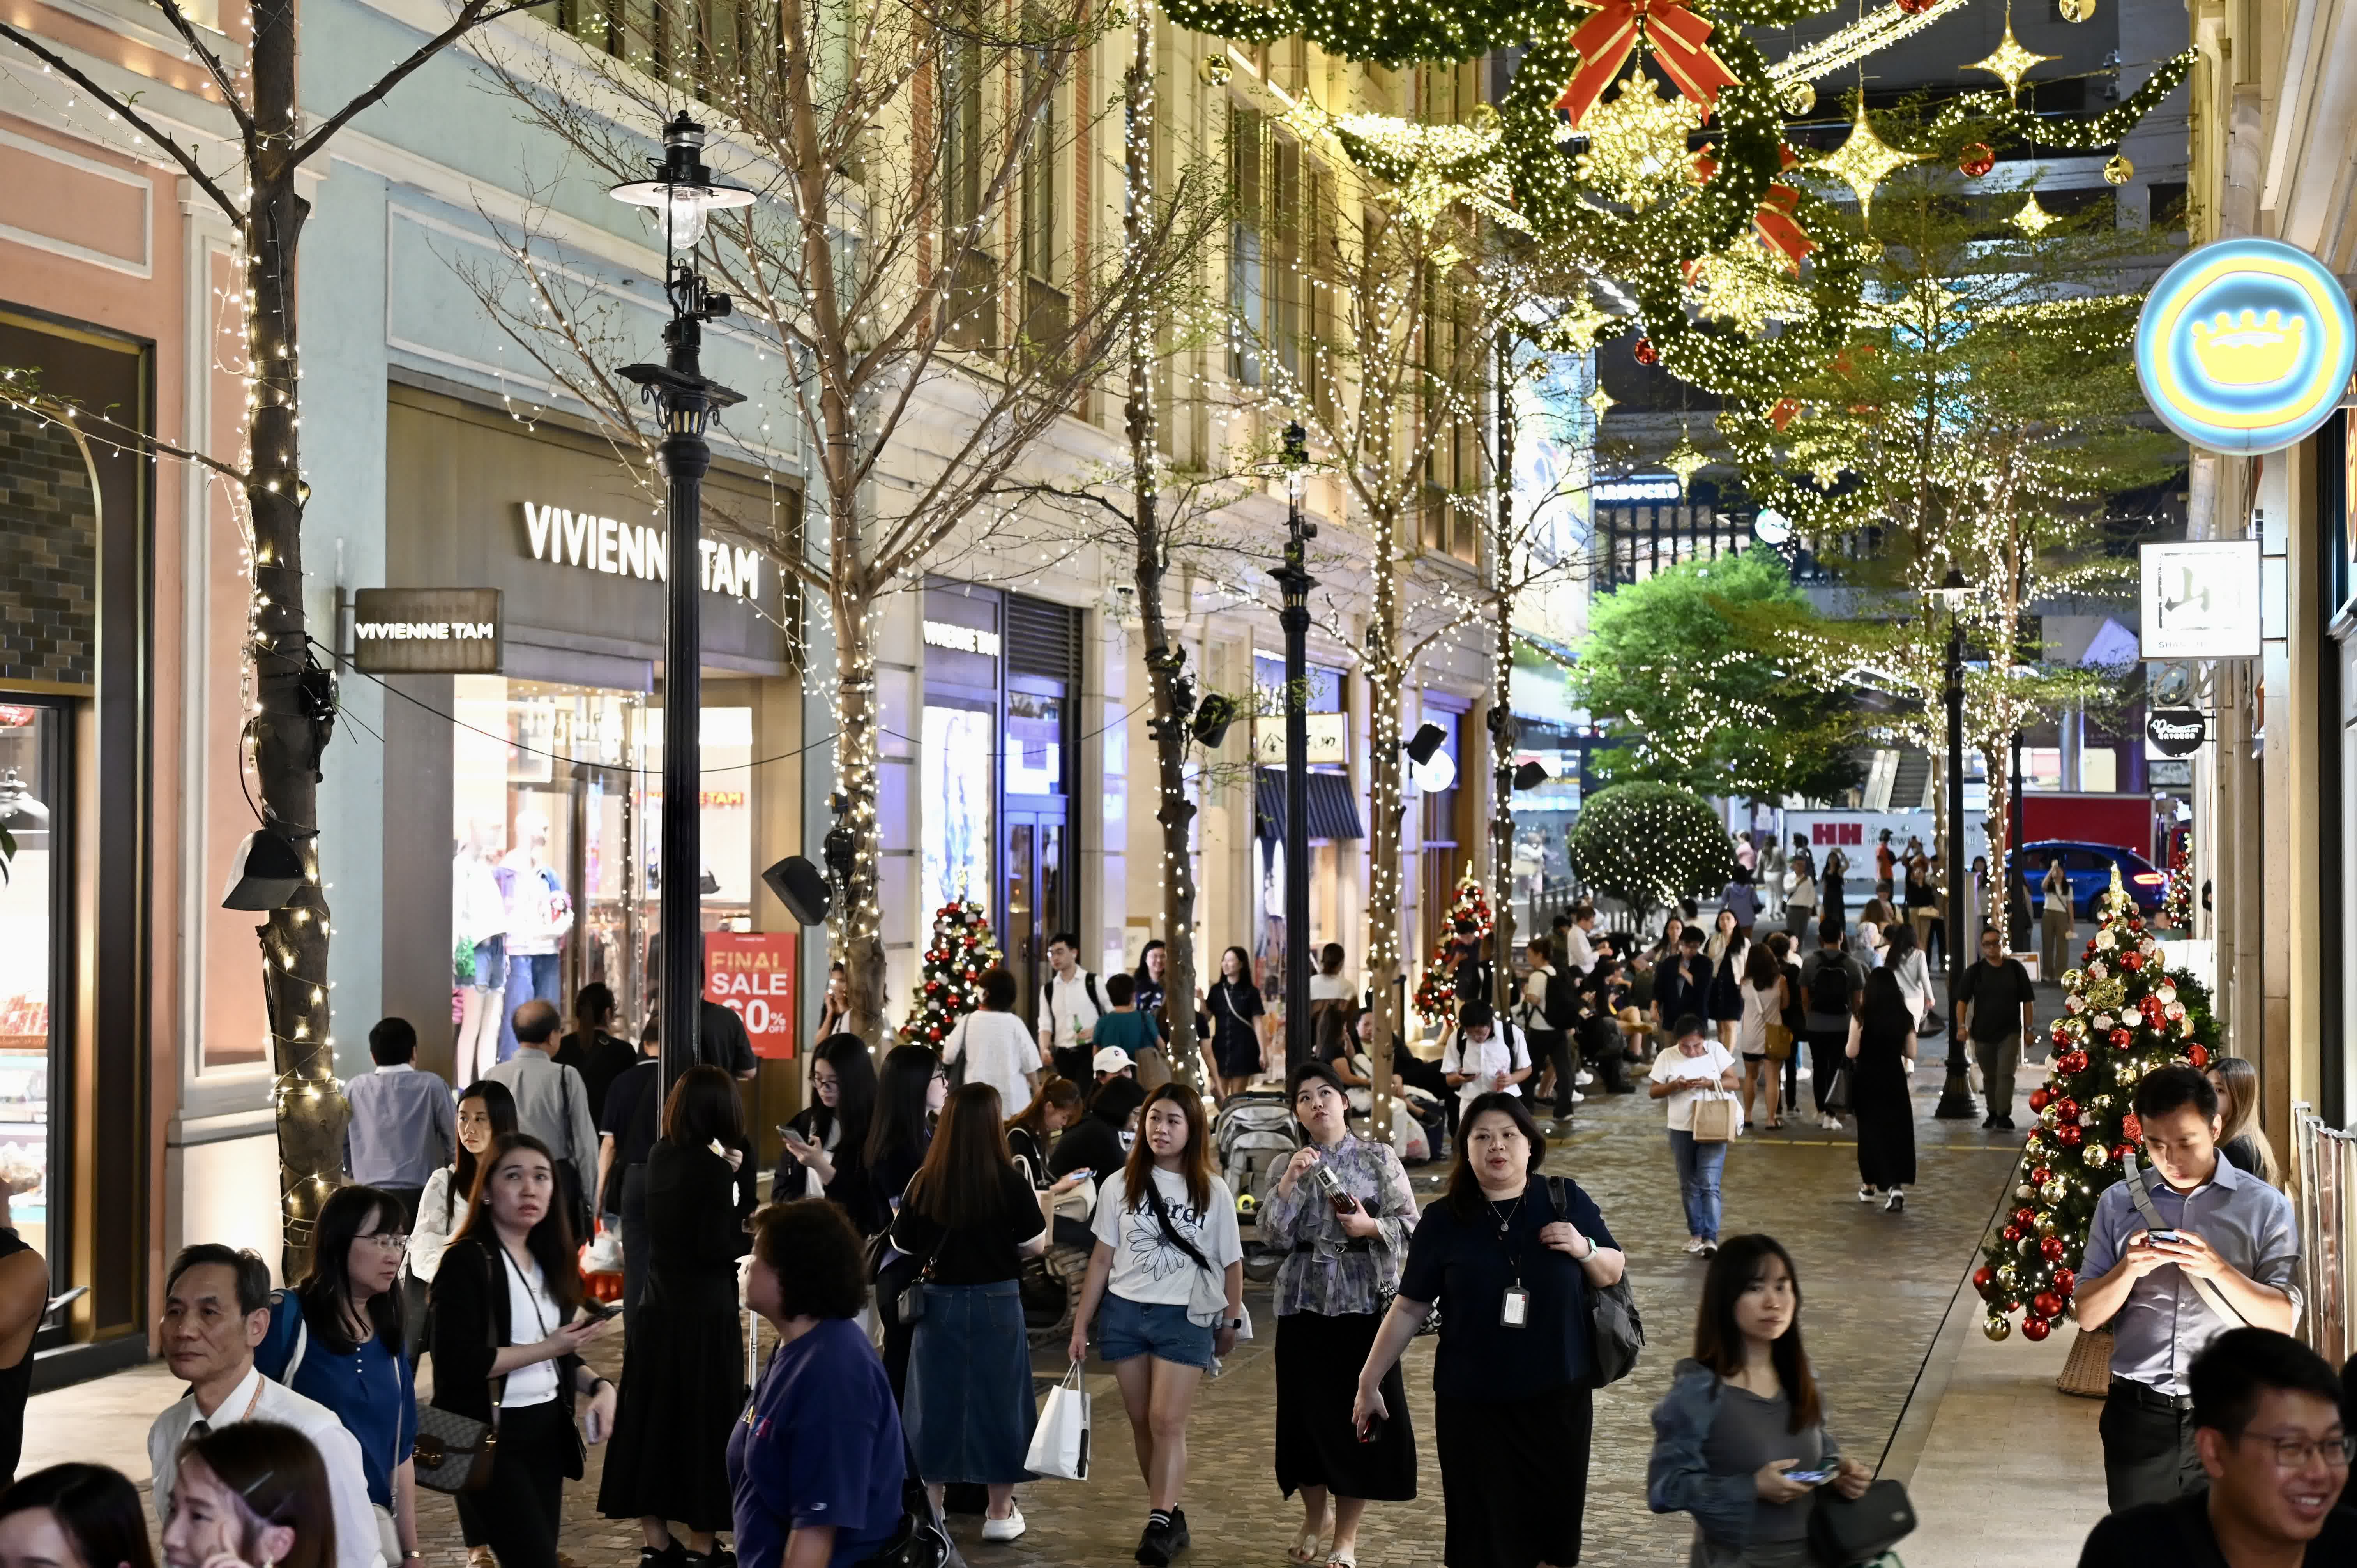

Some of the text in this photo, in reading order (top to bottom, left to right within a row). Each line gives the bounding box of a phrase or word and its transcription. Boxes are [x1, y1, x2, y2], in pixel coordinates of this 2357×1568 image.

[1592, 483, 1679, 500] ARBUCKS
[524, 501, 758, 599] VIVIENN TAM
[355, 623, 493, 639] VIVIENNE TAM
[711, 951, 788, 973] FINAL
[712, 973, 787, 995] SALE
